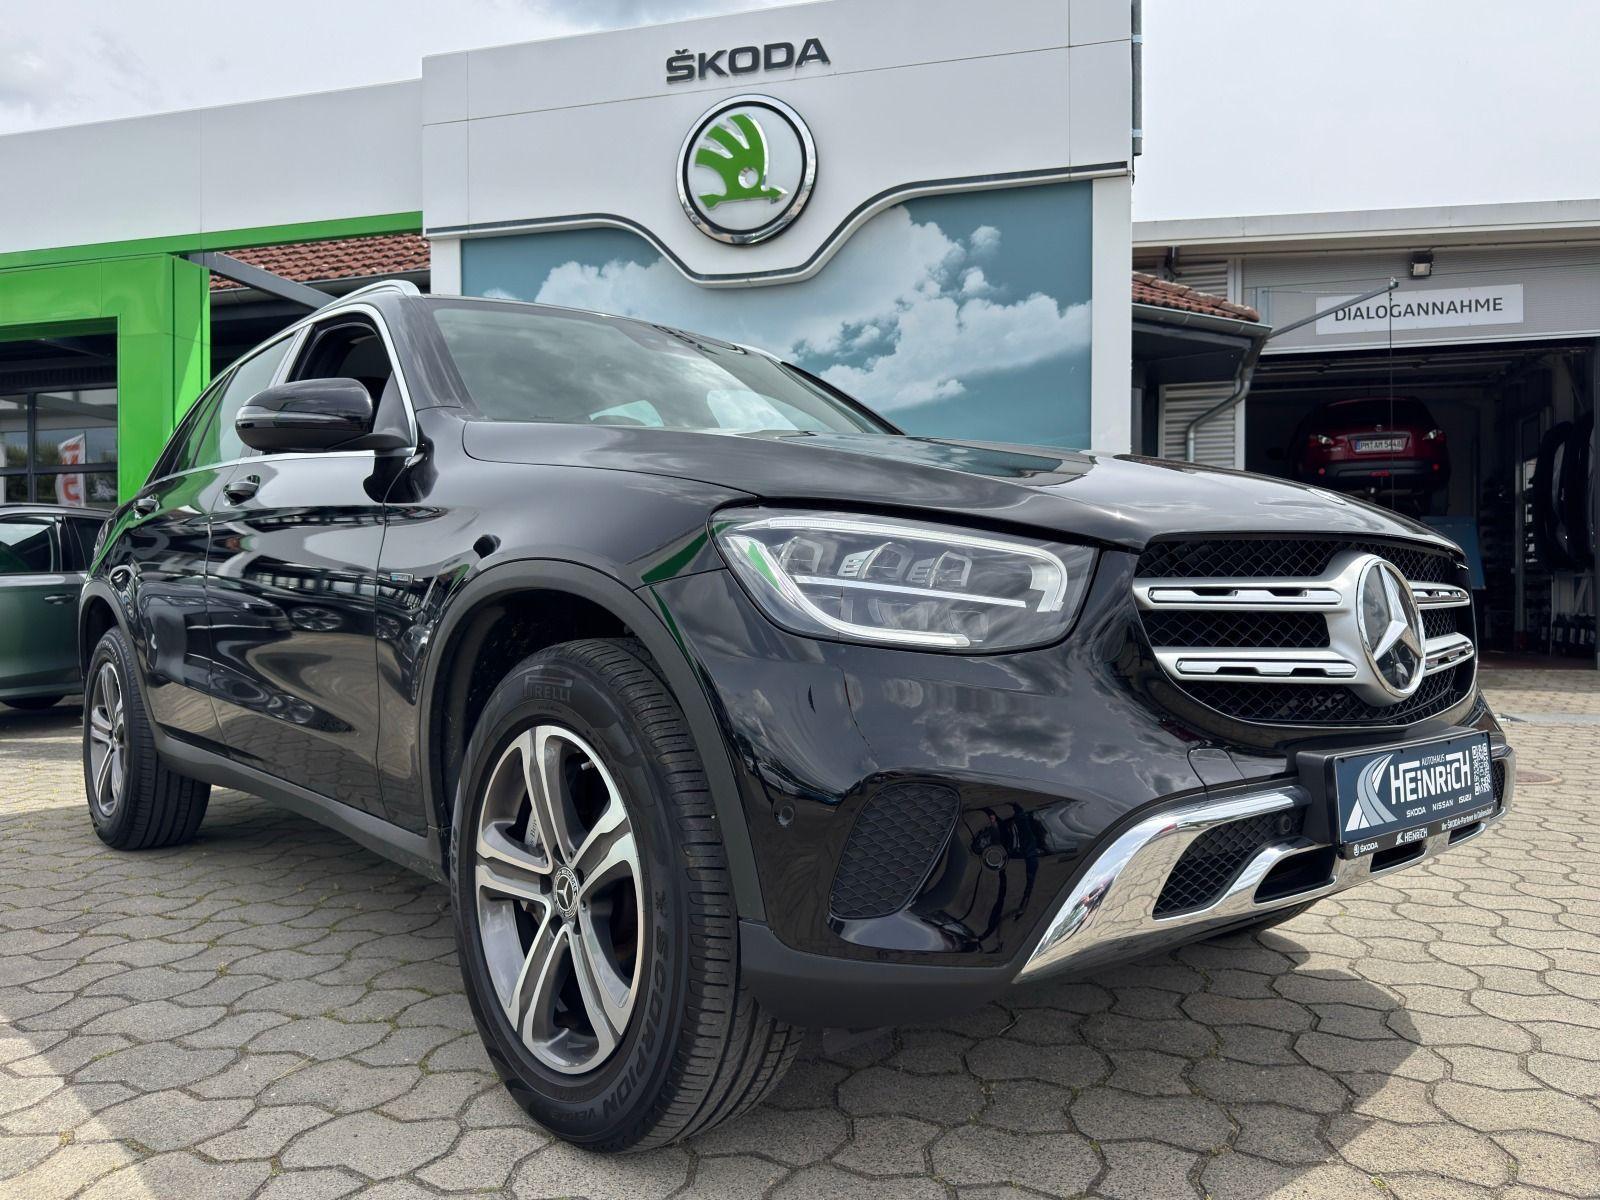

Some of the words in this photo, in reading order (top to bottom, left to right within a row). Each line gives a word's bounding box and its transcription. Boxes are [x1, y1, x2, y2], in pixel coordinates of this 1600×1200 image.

[666, 38, 830, 84] ŠKODA
[1335, 297, 1503, 322] DIALOGANNAHME
[523, 675, 573, 702] PIRELLI
[1421, 753, 1446, 767] AUTOHAUS
[1432, 799, 1453, 811] NISSAN
[1458, 793, 1472, 804] ISUZU
[602, 925, 668, 1121] SCORPION
